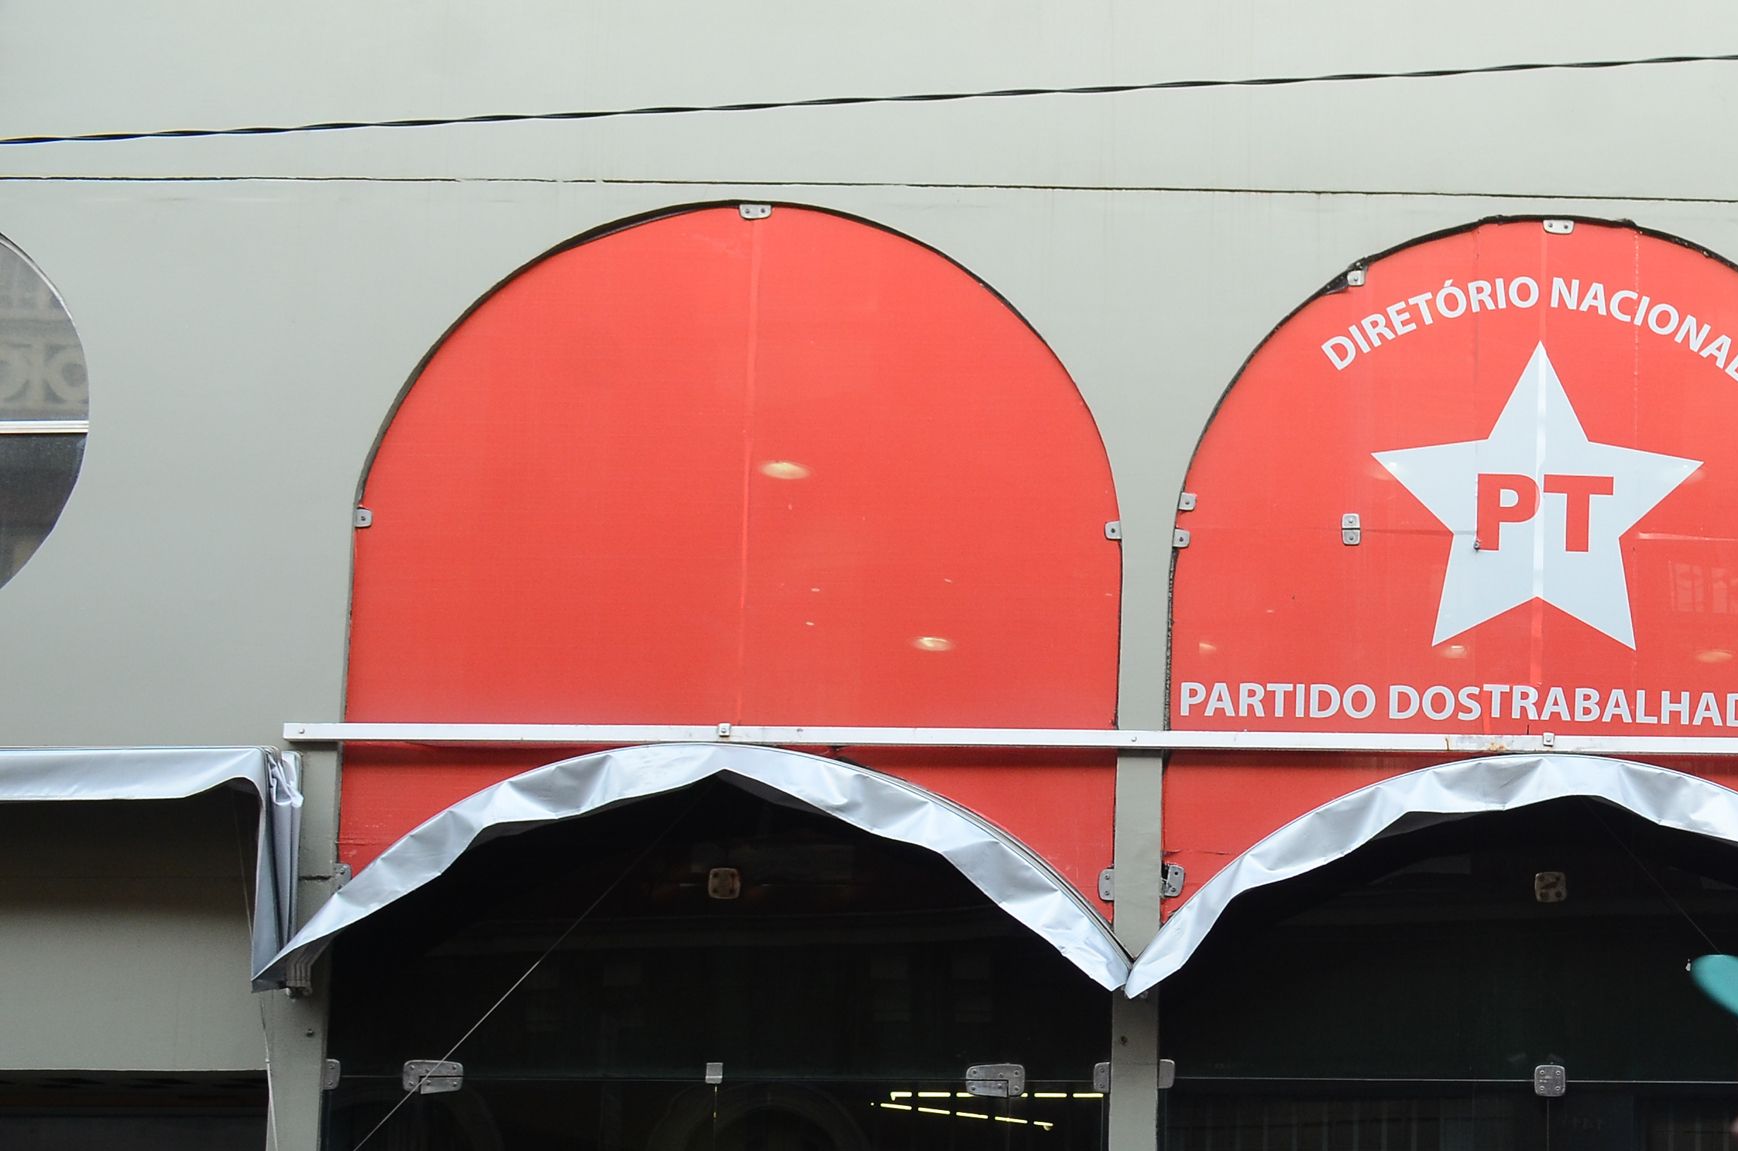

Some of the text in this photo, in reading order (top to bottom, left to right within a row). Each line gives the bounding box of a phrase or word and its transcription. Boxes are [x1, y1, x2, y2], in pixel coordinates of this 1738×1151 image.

[1321, 276, 1539, 370] DIRETÓRIO
[1477, 474, 1613, 552] PT
[1180, 682, 1376, 719] PARTIDO
